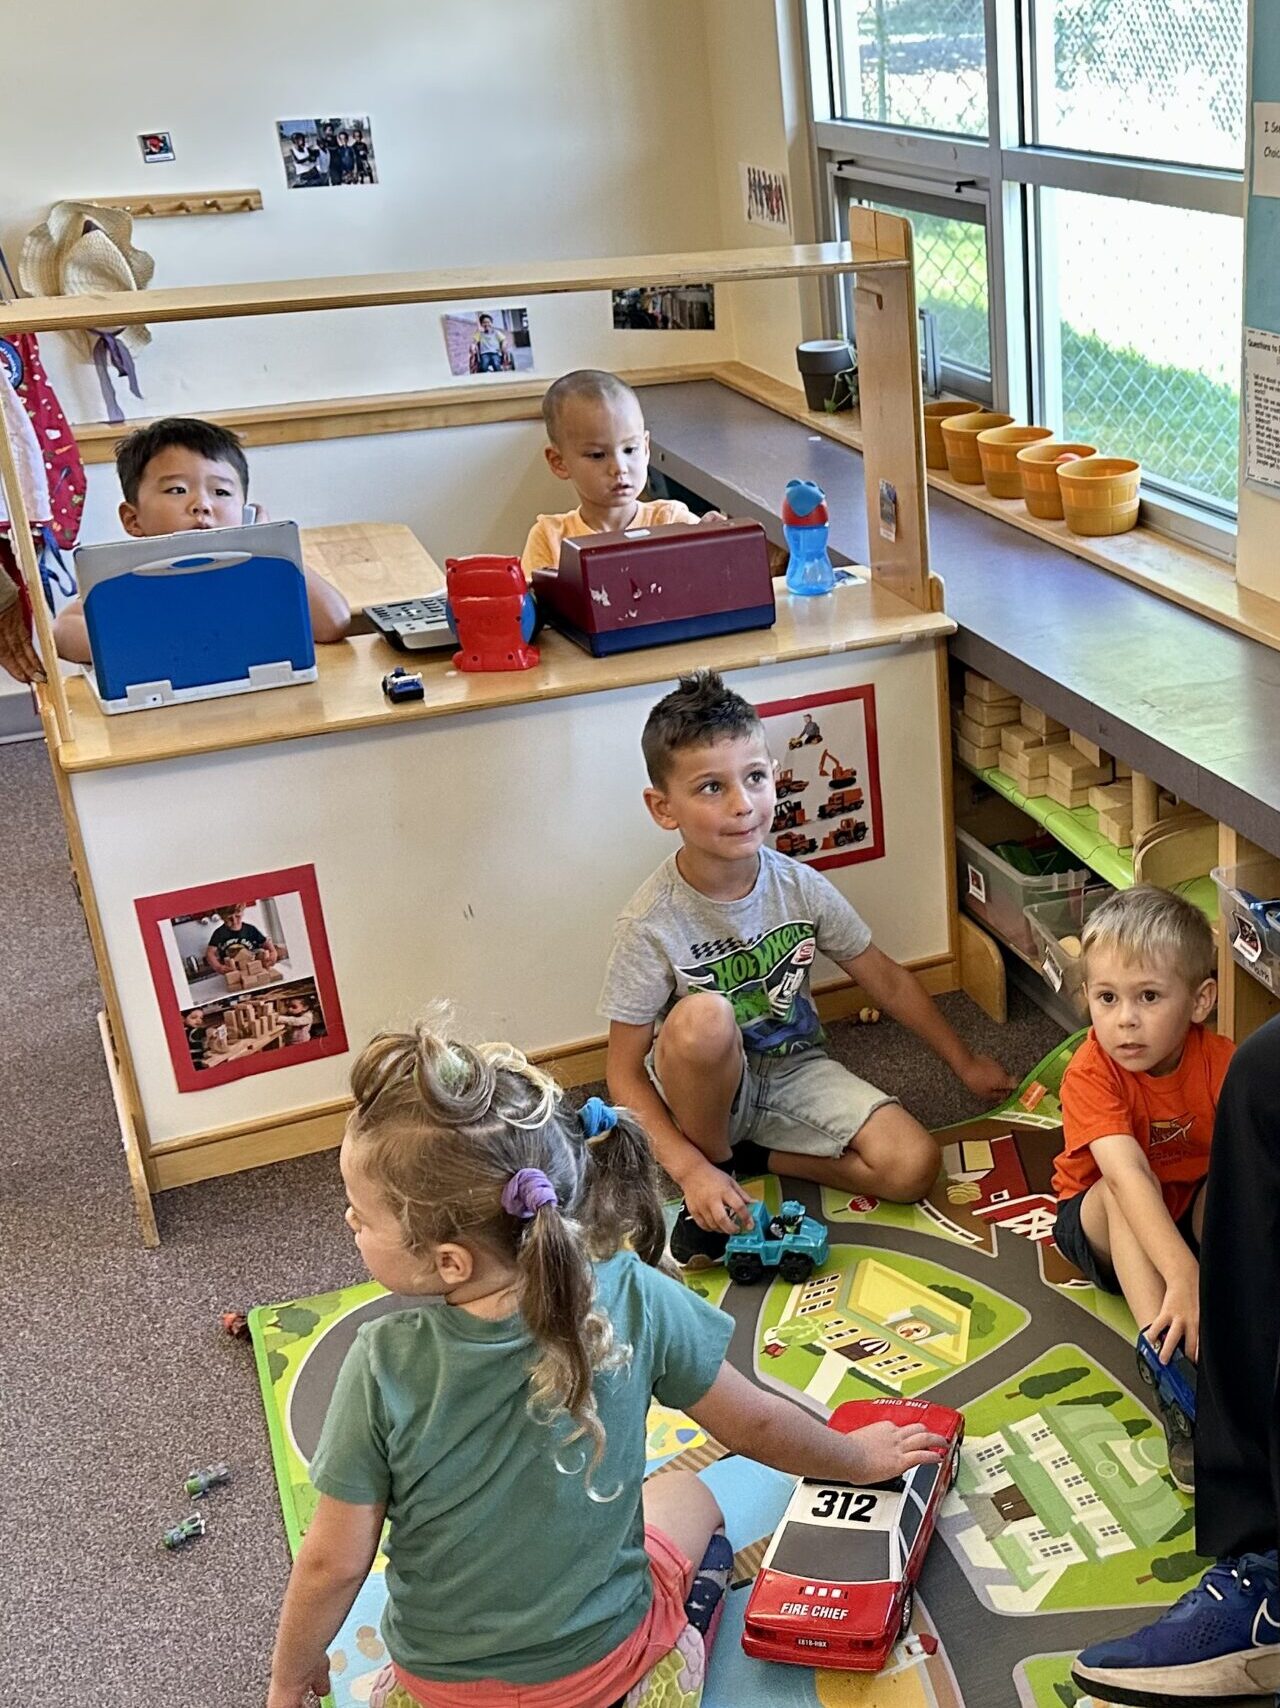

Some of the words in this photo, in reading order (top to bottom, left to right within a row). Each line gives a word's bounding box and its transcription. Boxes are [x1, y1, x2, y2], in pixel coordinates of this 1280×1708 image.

[904, 1400, 929, 1409] FIRE
[811, 1490, 878, 1523] 312
[780, 1602, 809, 1616] FIRE
[811, 1605, 849, 1620] CHIEF
